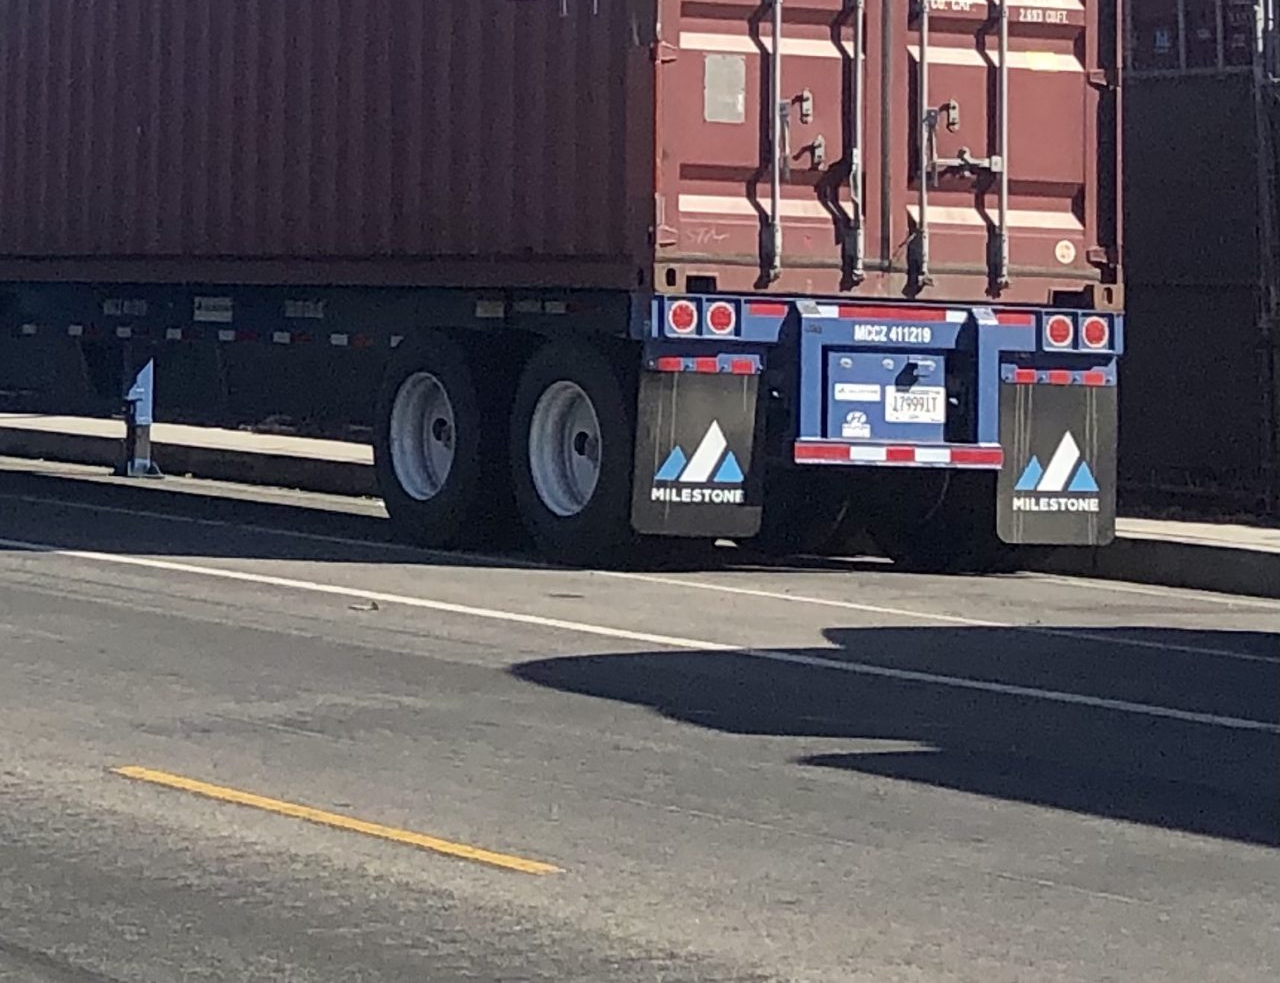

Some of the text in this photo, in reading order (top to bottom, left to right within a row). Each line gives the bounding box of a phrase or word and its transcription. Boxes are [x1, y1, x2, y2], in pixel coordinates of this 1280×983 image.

[889, 326, 931, 343] 411219
[651, 487, 745, 504] MILESTONE
[1012, 497, 1100, 512] MILESTONE
